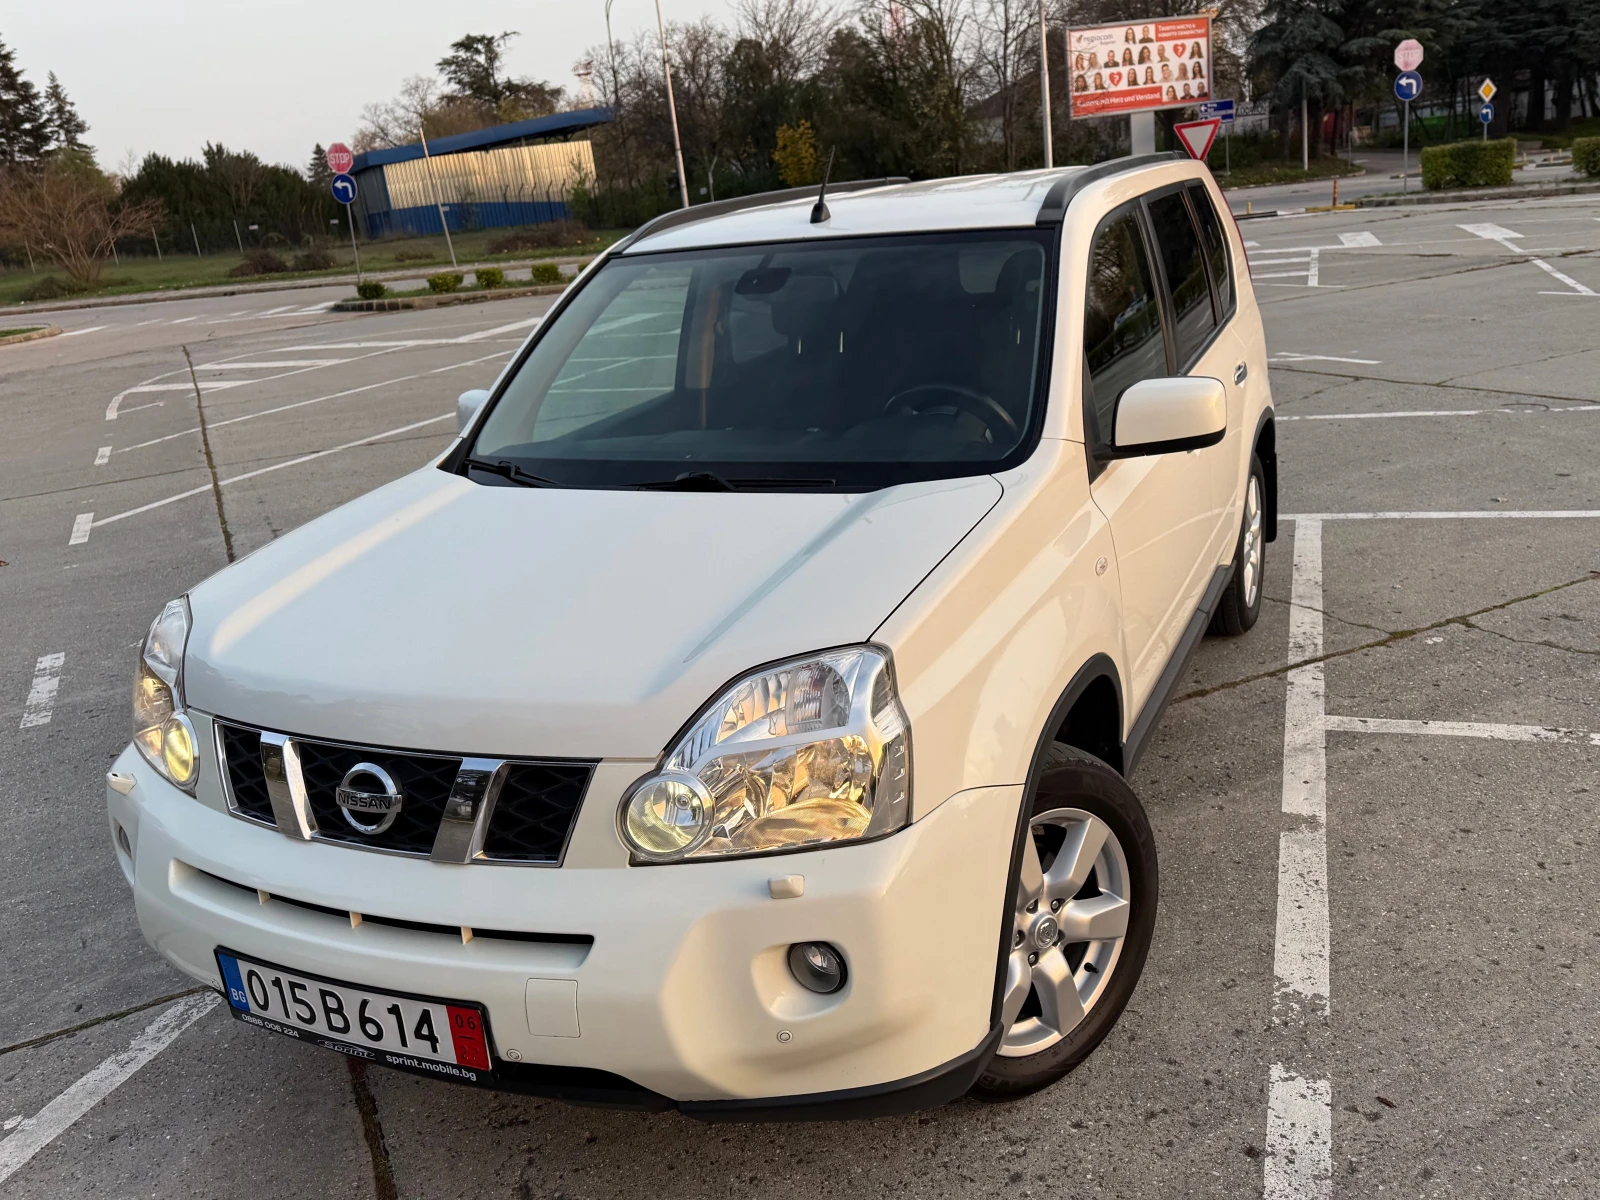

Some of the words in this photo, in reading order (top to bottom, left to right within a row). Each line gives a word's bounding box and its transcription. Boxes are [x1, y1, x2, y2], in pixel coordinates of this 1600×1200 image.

[329, 152, 350, 164] STOP
[338, 791, 391, 809] NISSAN
[231, 988, 247, 1003] BG
[246, 969, 440, 1054] 015B614
[455, 1014, 476, 1030] 06
[386, 1054, 477, 1081] sprint.mobile.bg
